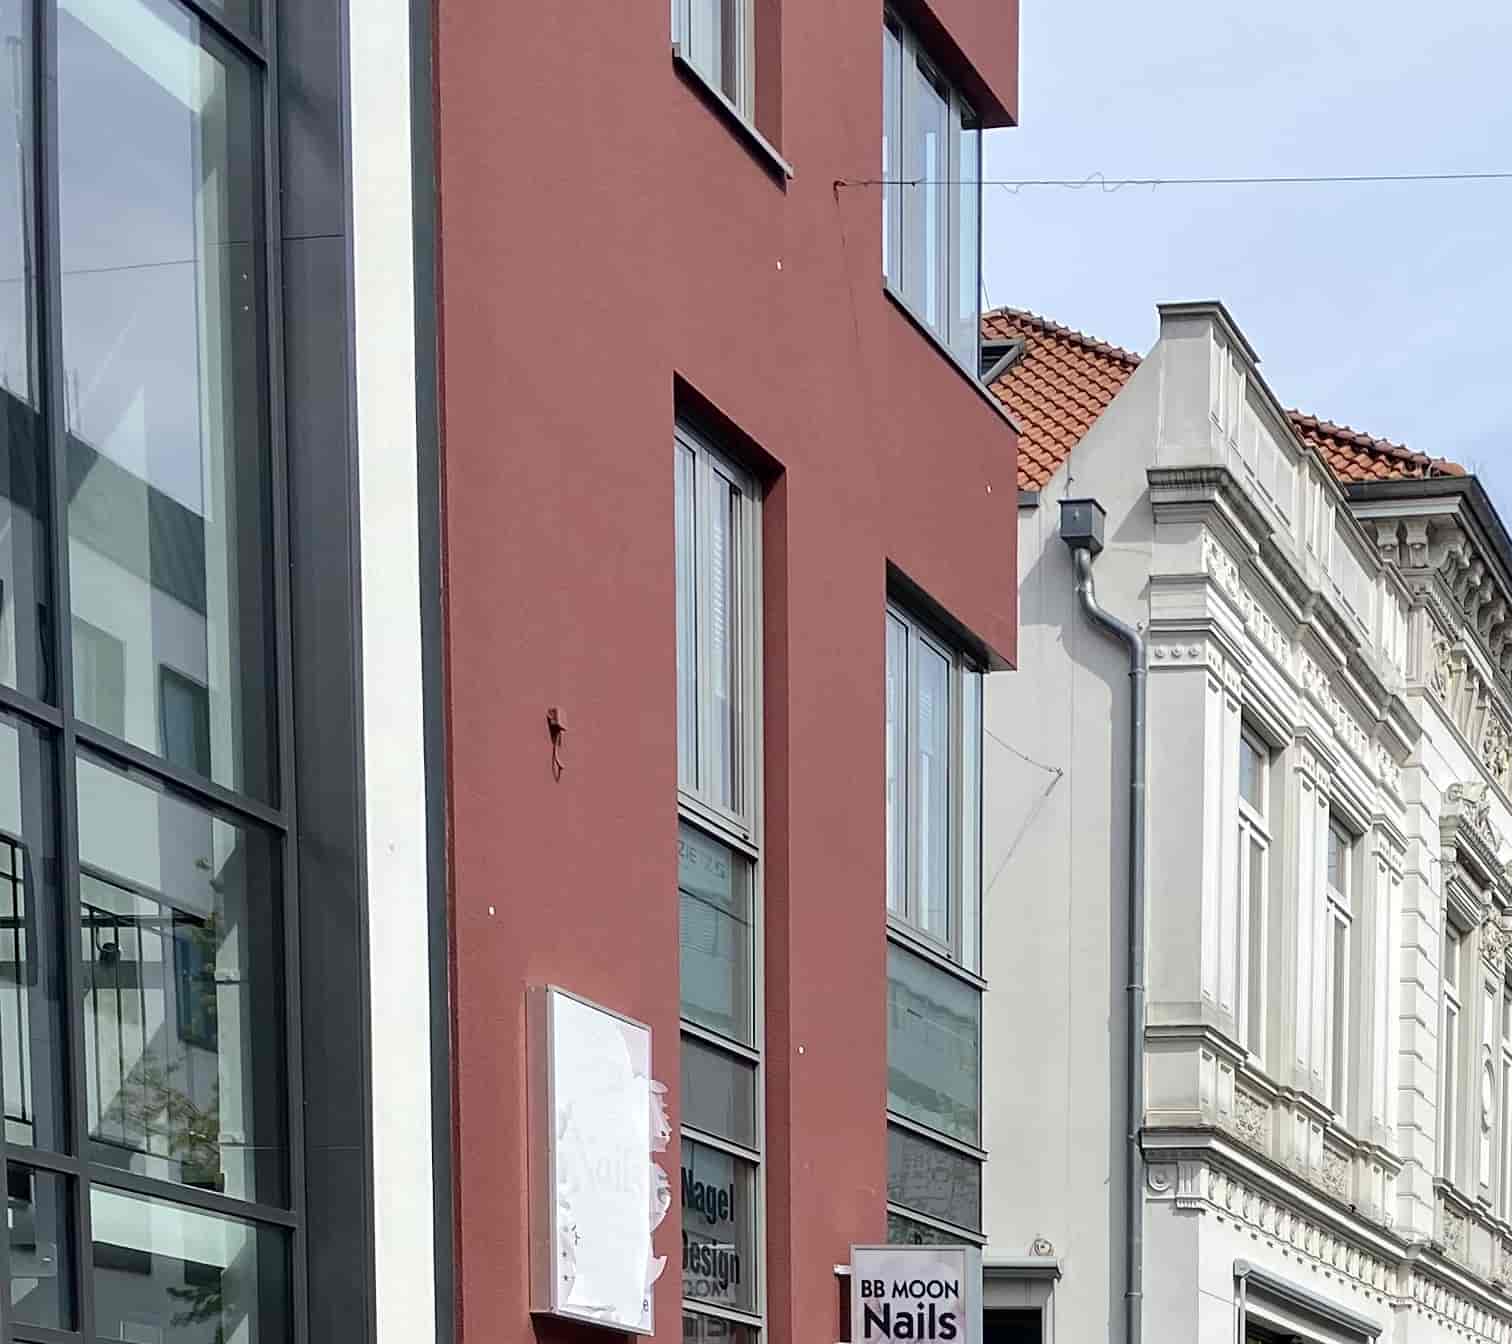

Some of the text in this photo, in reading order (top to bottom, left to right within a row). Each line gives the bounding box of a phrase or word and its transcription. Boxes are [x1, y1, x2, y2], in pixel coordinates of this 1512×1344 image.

[681, 1166, 734, 1224] Nagel
[861, 1279, 959, 1299] BB MOON
[864, 1301, 957, 1340] Nails
